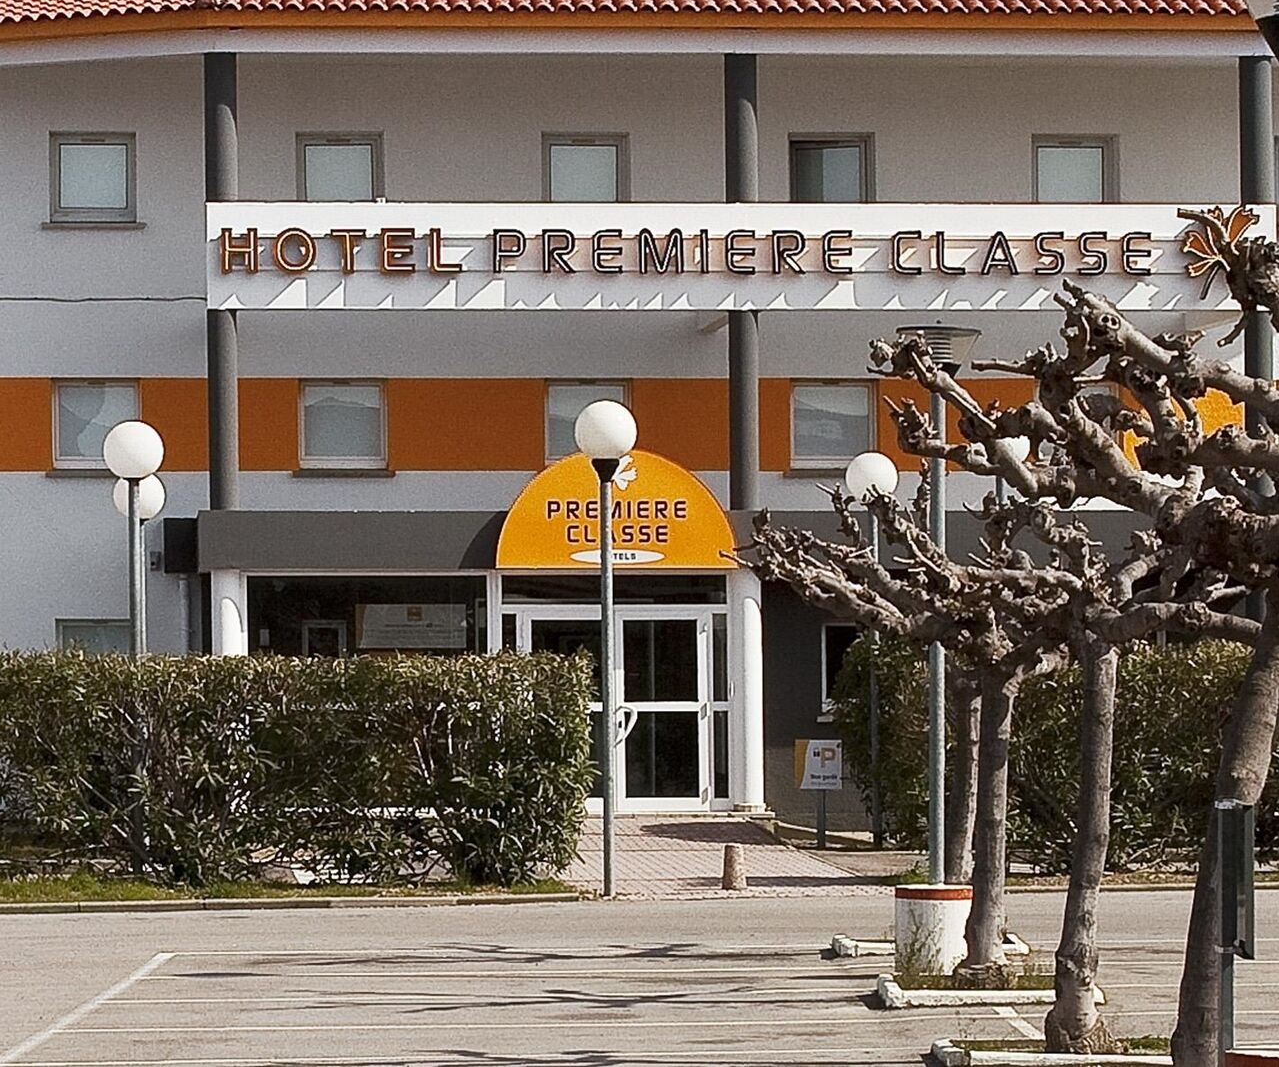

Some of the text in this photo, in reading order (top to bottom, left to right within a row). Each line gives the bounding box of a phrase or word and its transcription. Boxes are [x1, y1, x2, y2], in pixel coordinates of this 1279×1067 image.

[220, 227, 1153, 276] HOTEL PREMIERE CLASSE
[566, 525, 669, 543] CLSSE
